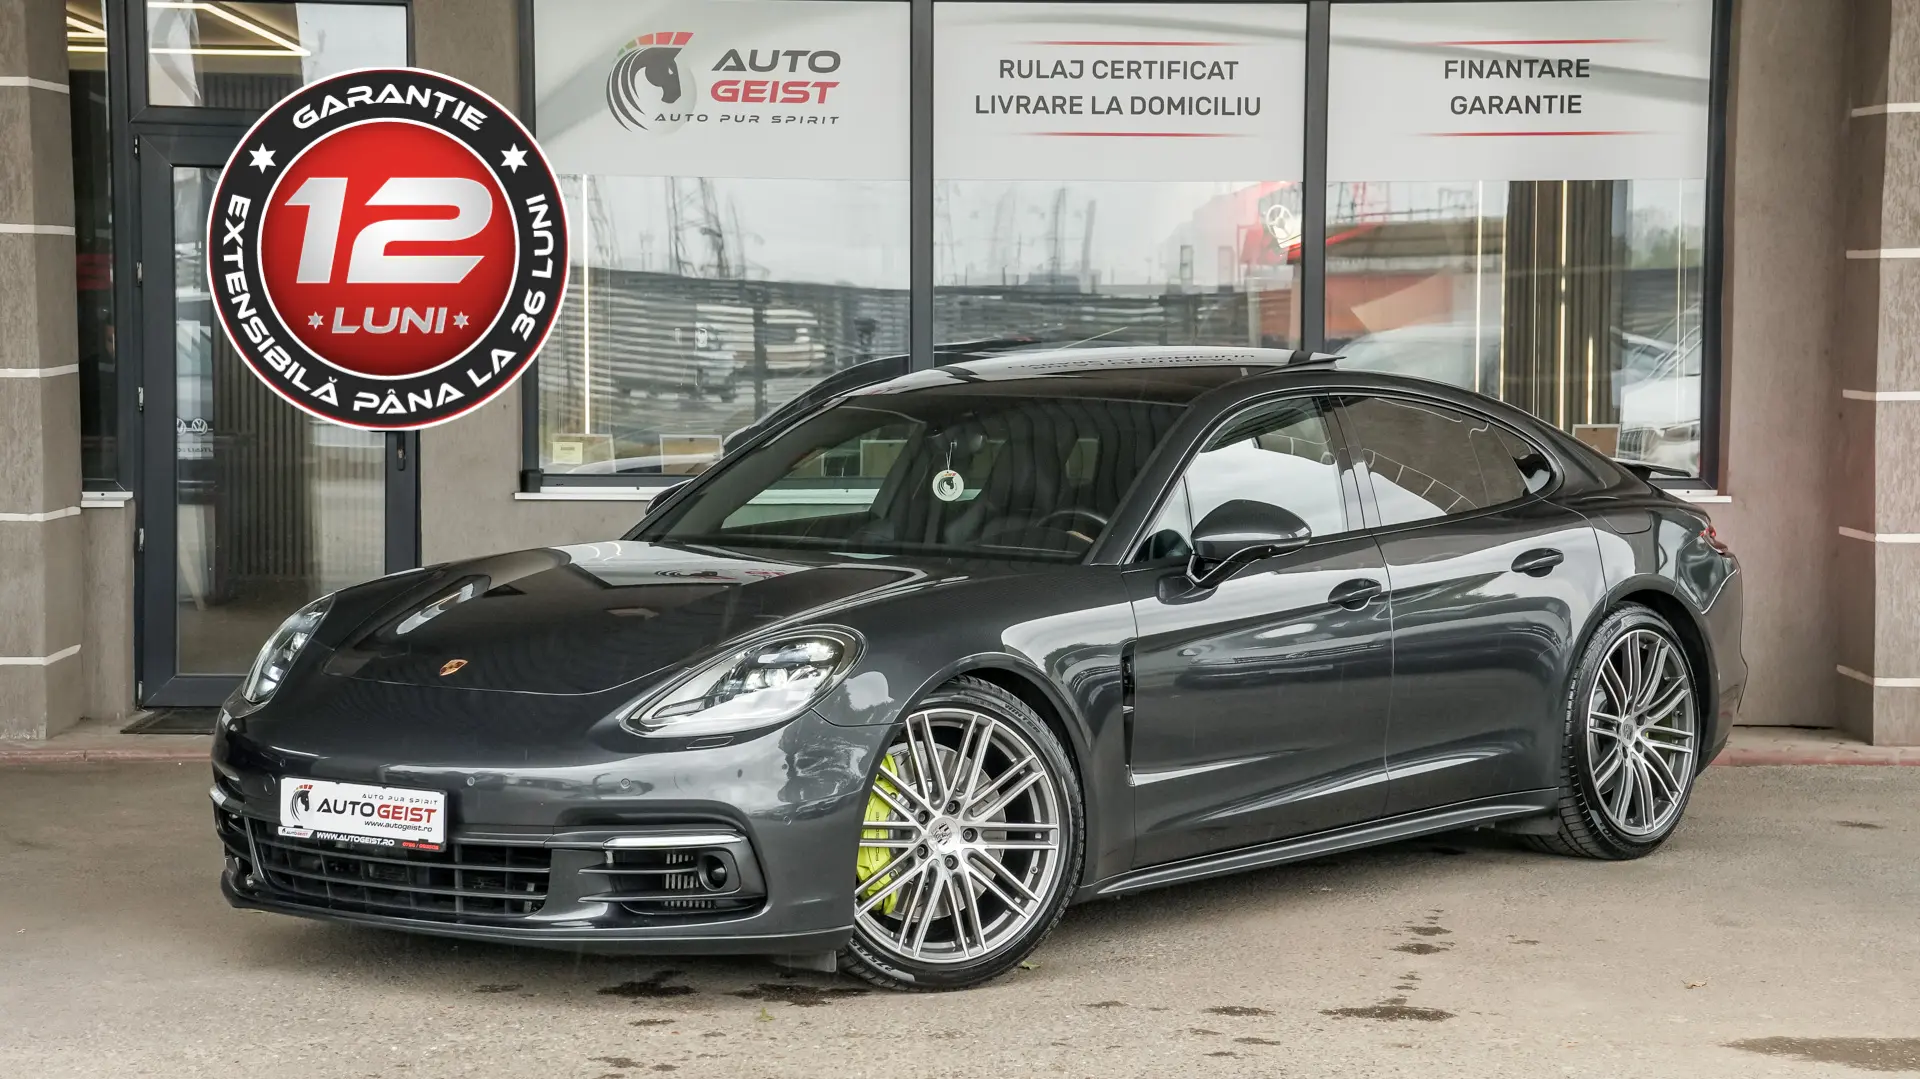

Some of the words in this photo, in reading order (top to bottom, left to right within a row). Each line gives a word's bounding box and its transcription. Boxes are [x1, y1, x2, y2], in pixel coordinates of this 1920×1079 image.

[711, 48, 841, 74] AUTO
[999, 59, 1084, 80] RULAJ
[1092, 60, 1239, 80] CERTIFICAT
[1444, 58, 1591, 79] FINANTARE
[710, 79, 840, 104] GEIST
[975, 94, 1083, 115] LIVRARE
[1090, 95, 1124, 115] LA
[1130, 96, 1261, 116] DOMICILIU
[1450, 94, 1582, 115] GARANTIE
[654, 113, 709, 122] AUTO
[719, 114, 760, 124] PUR
[771, 115, 840, 125] SPIRIT
[364, 820, 433, 833] www.autogeist.ro
[316, 831, 395, 846] WWW.AUTOGEIST.RO
